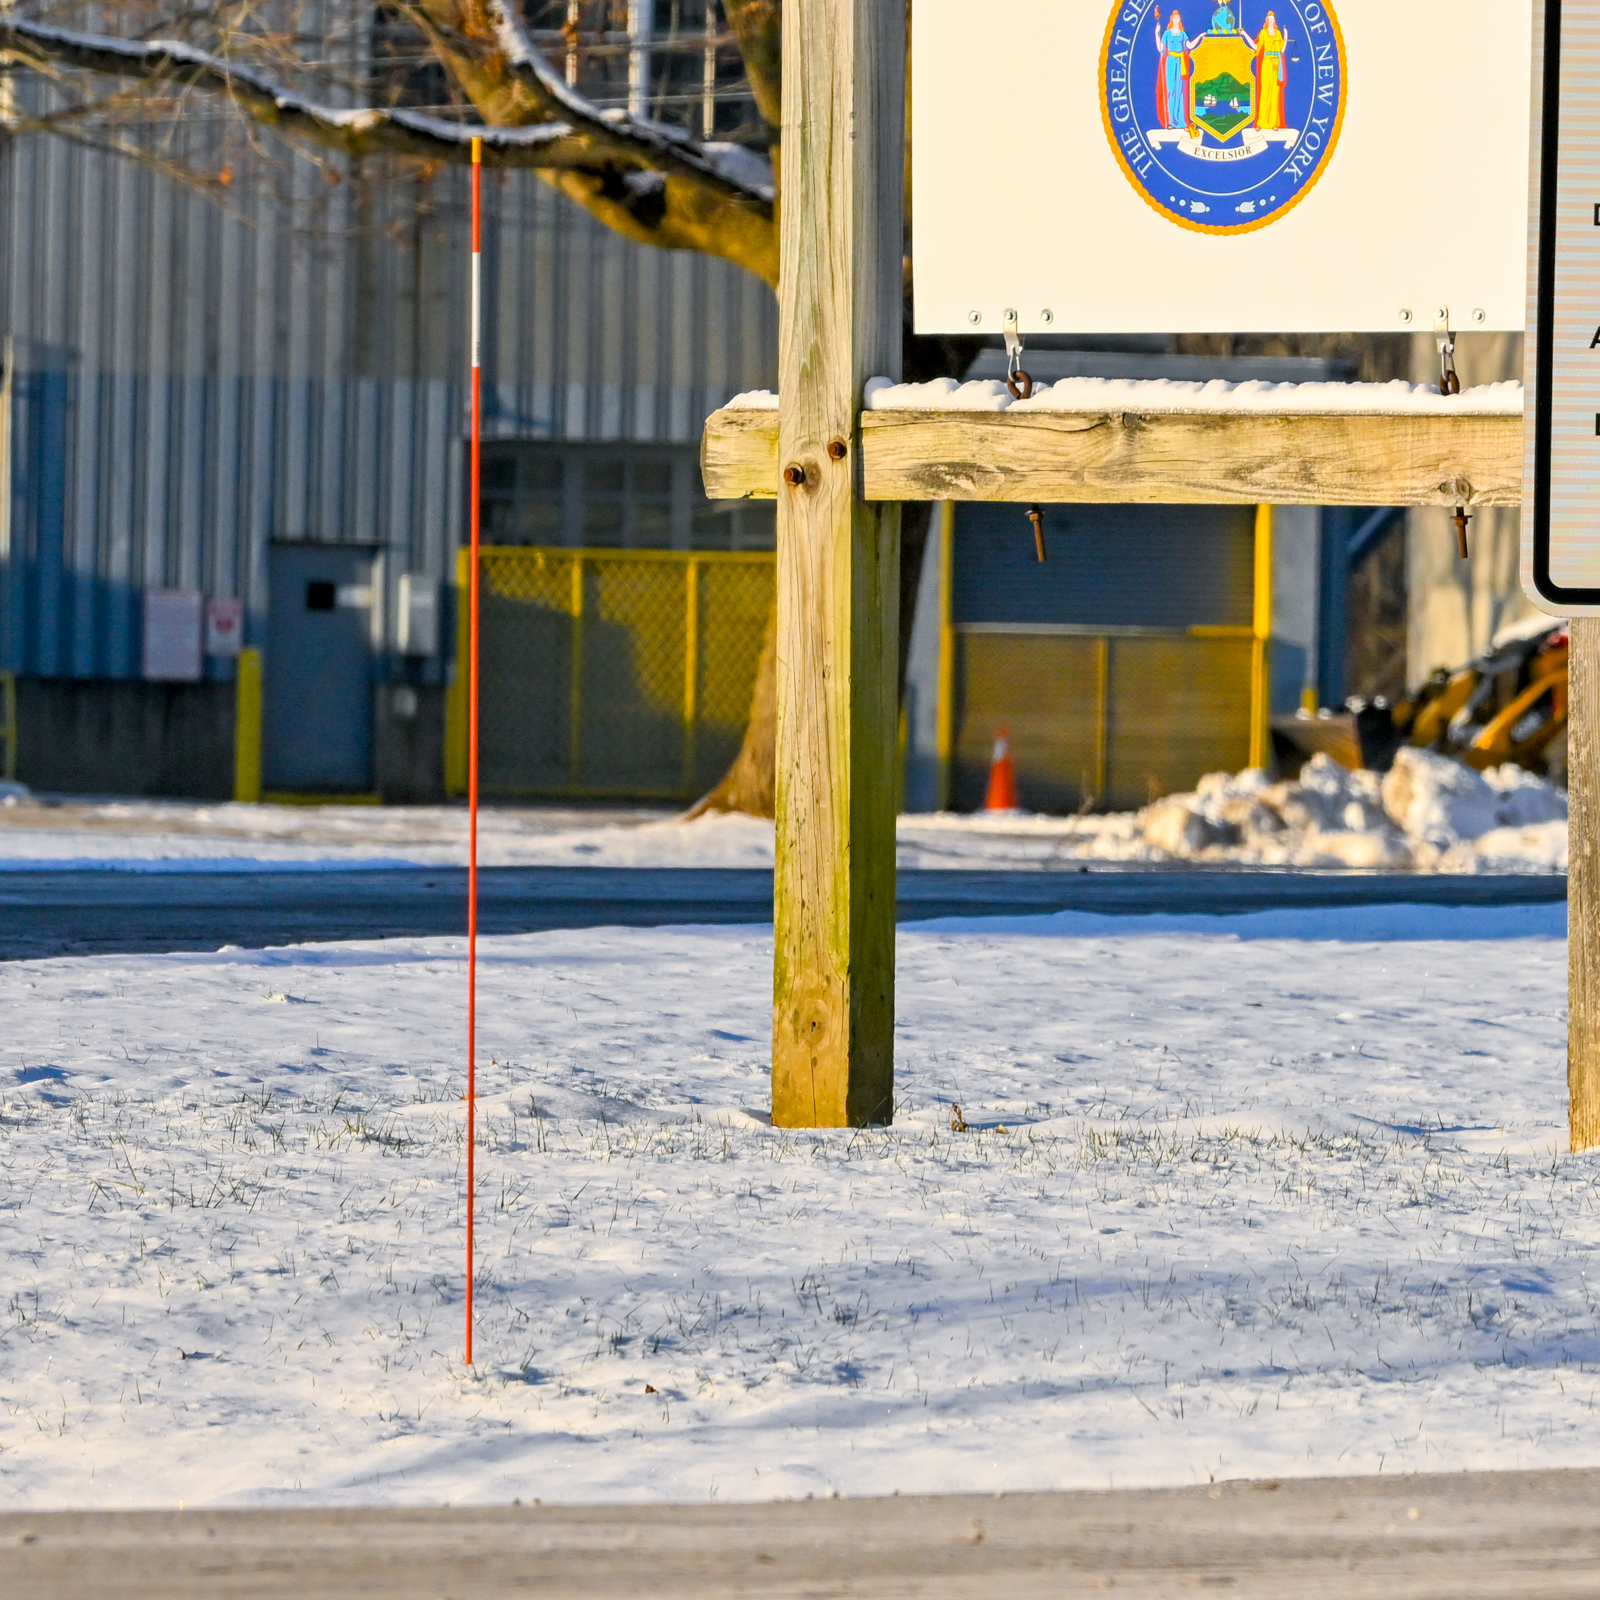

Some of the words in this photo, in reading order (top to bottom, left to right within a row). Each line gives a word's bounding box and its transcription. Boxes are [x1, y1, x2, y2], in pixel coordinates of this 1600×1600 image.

[1304, 2, 1327, 34] OF
[1111, 30, 1130, 122] GREAT
[1316, 43, 1335, 106] NEW
[1121, 127, 1153, 179] THE
[1194, 145, 1252, 160] EXCELSIOR
[1283, 116, 1328, 183] YORK
